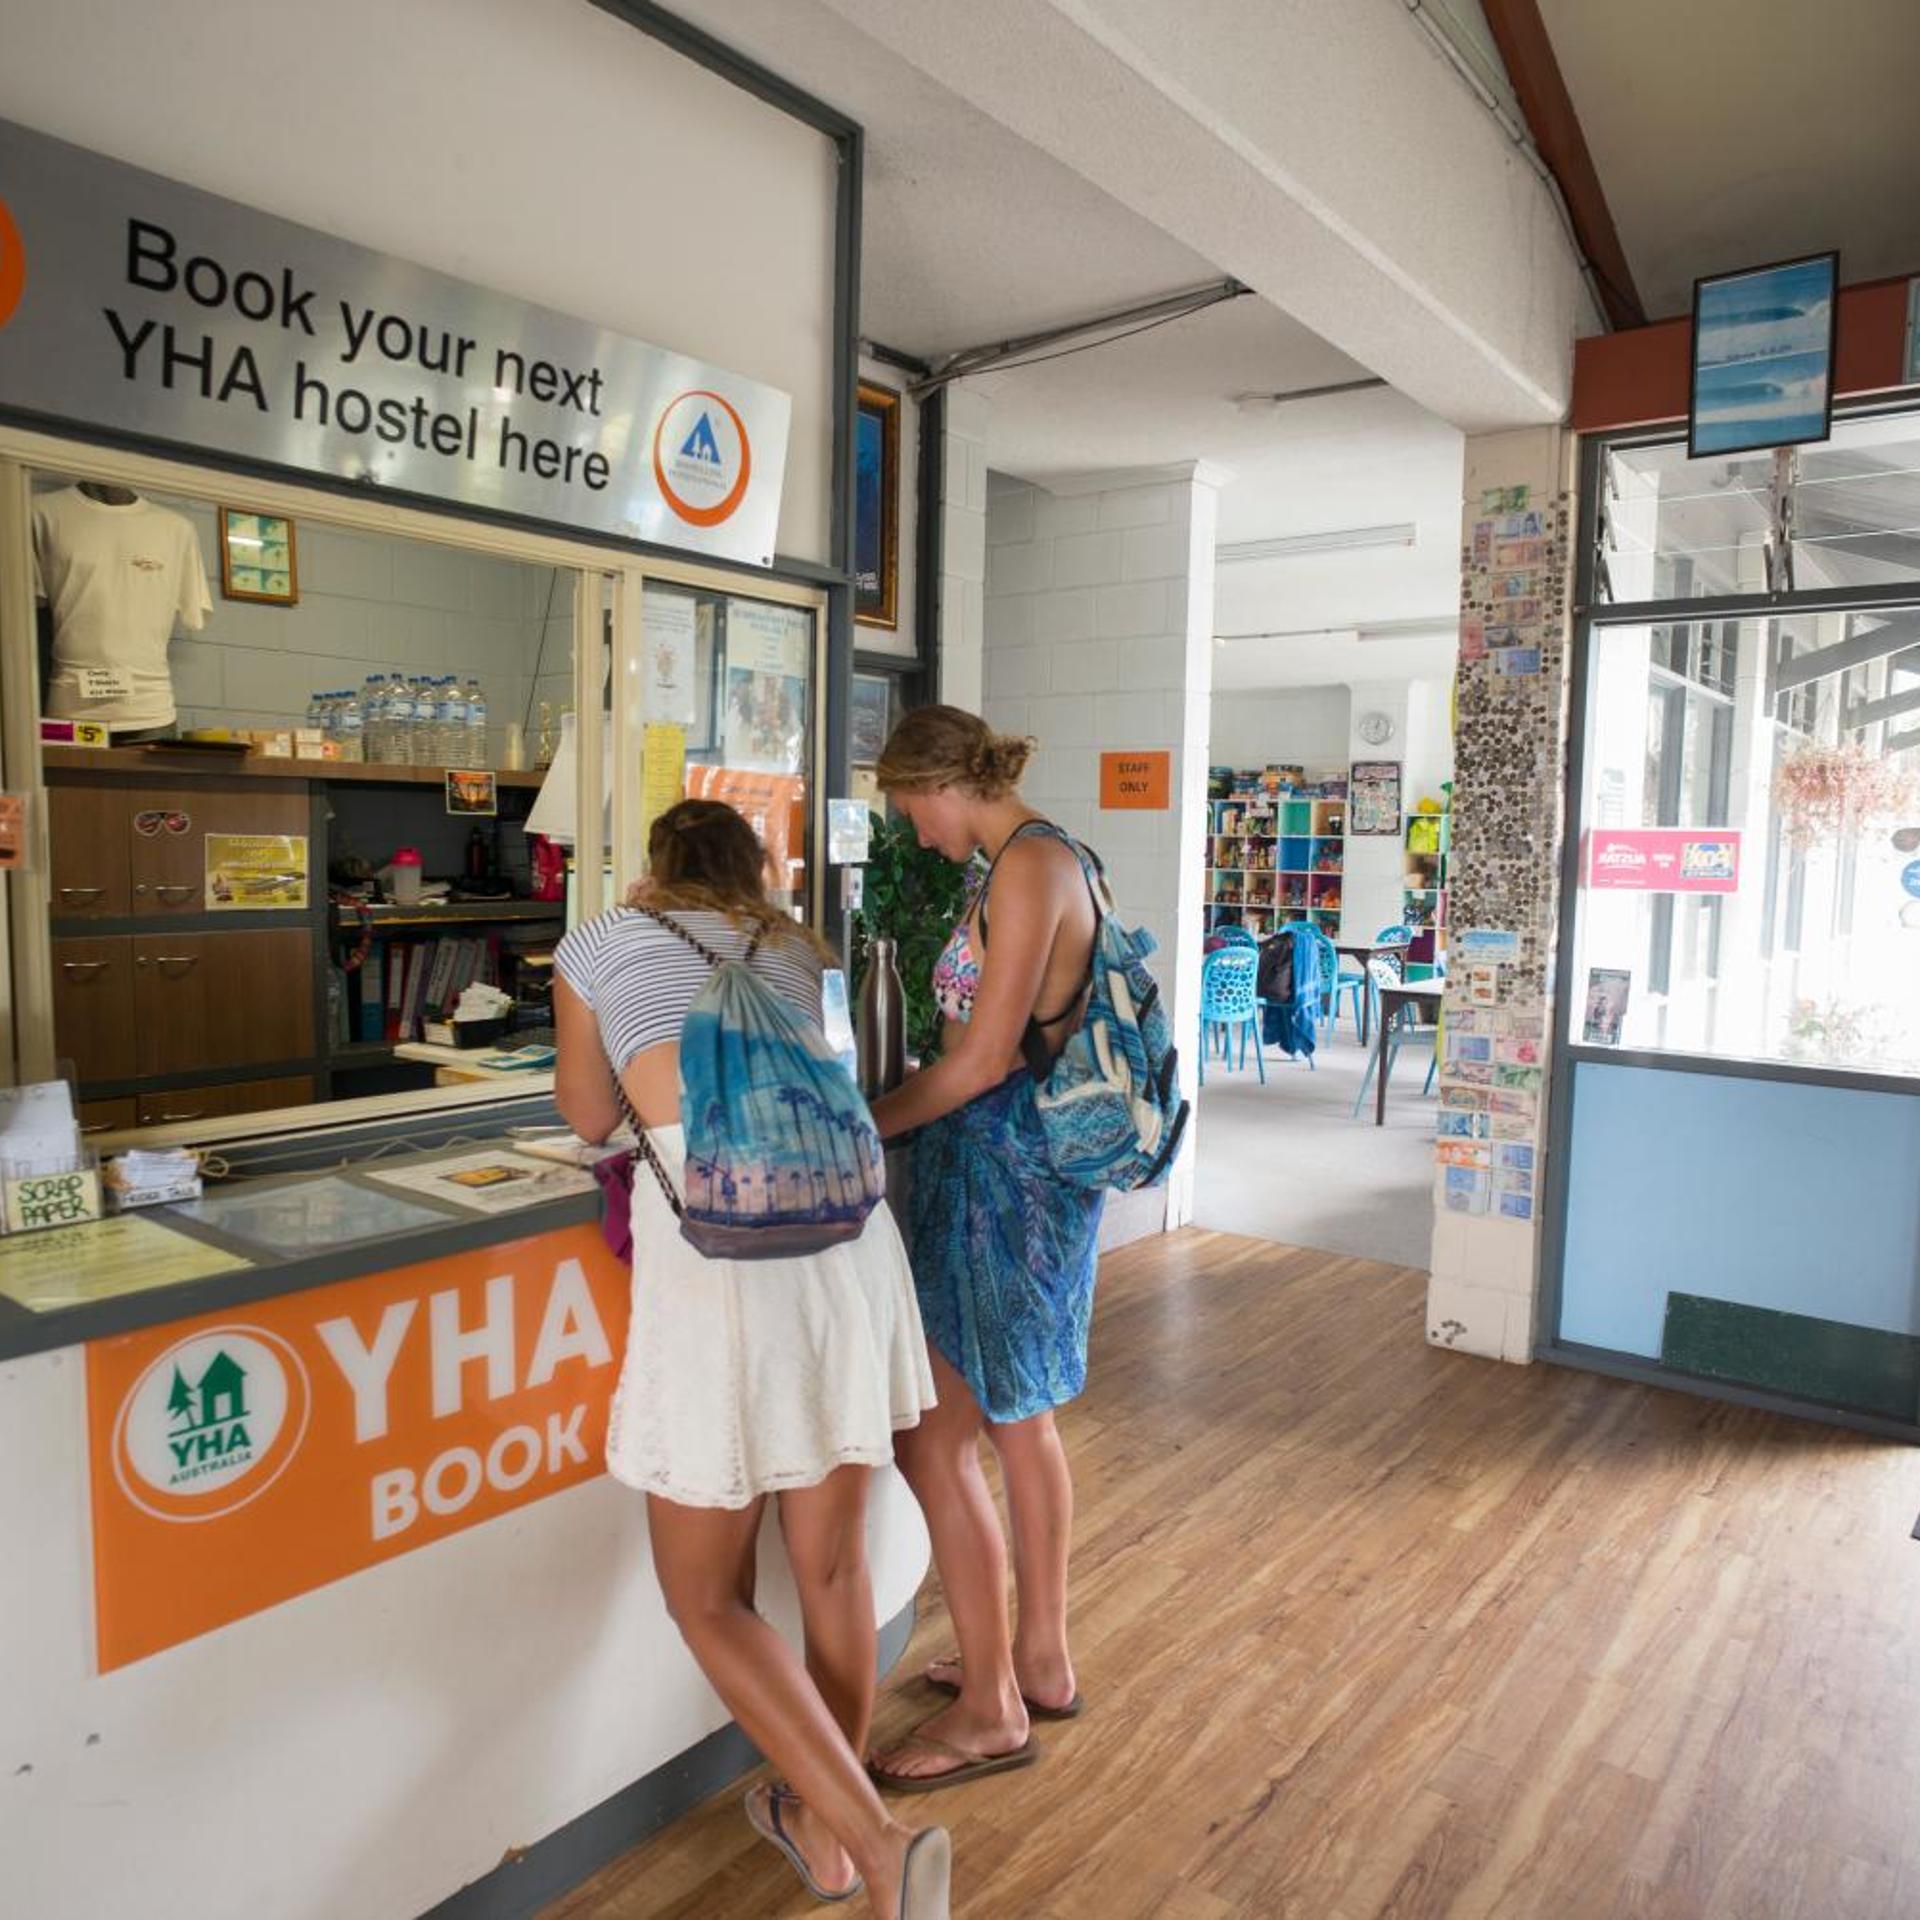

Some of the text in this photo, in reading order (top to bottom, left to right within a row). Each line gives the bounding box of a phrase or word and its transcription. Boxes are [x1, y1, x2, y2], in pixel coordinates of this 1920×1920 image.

[126, 217, 604, 416] Book your next
[104, 308, 610, 490] YHA hostel here
[1118, 762, 1150, 773] STAFF
[1119, 781, 1149, 793] ONLY
[18, 1175, 84, 1203] SCRAP
[21, 1196, 90, 1227] PAPER
[315, 1258, 612, 1444] YHA
[169, 1423, 252, 1468] YHA
[170, 1451, 252, 1485] AUSTRALIA
[372, 1405, 588, 1542] BOOK
